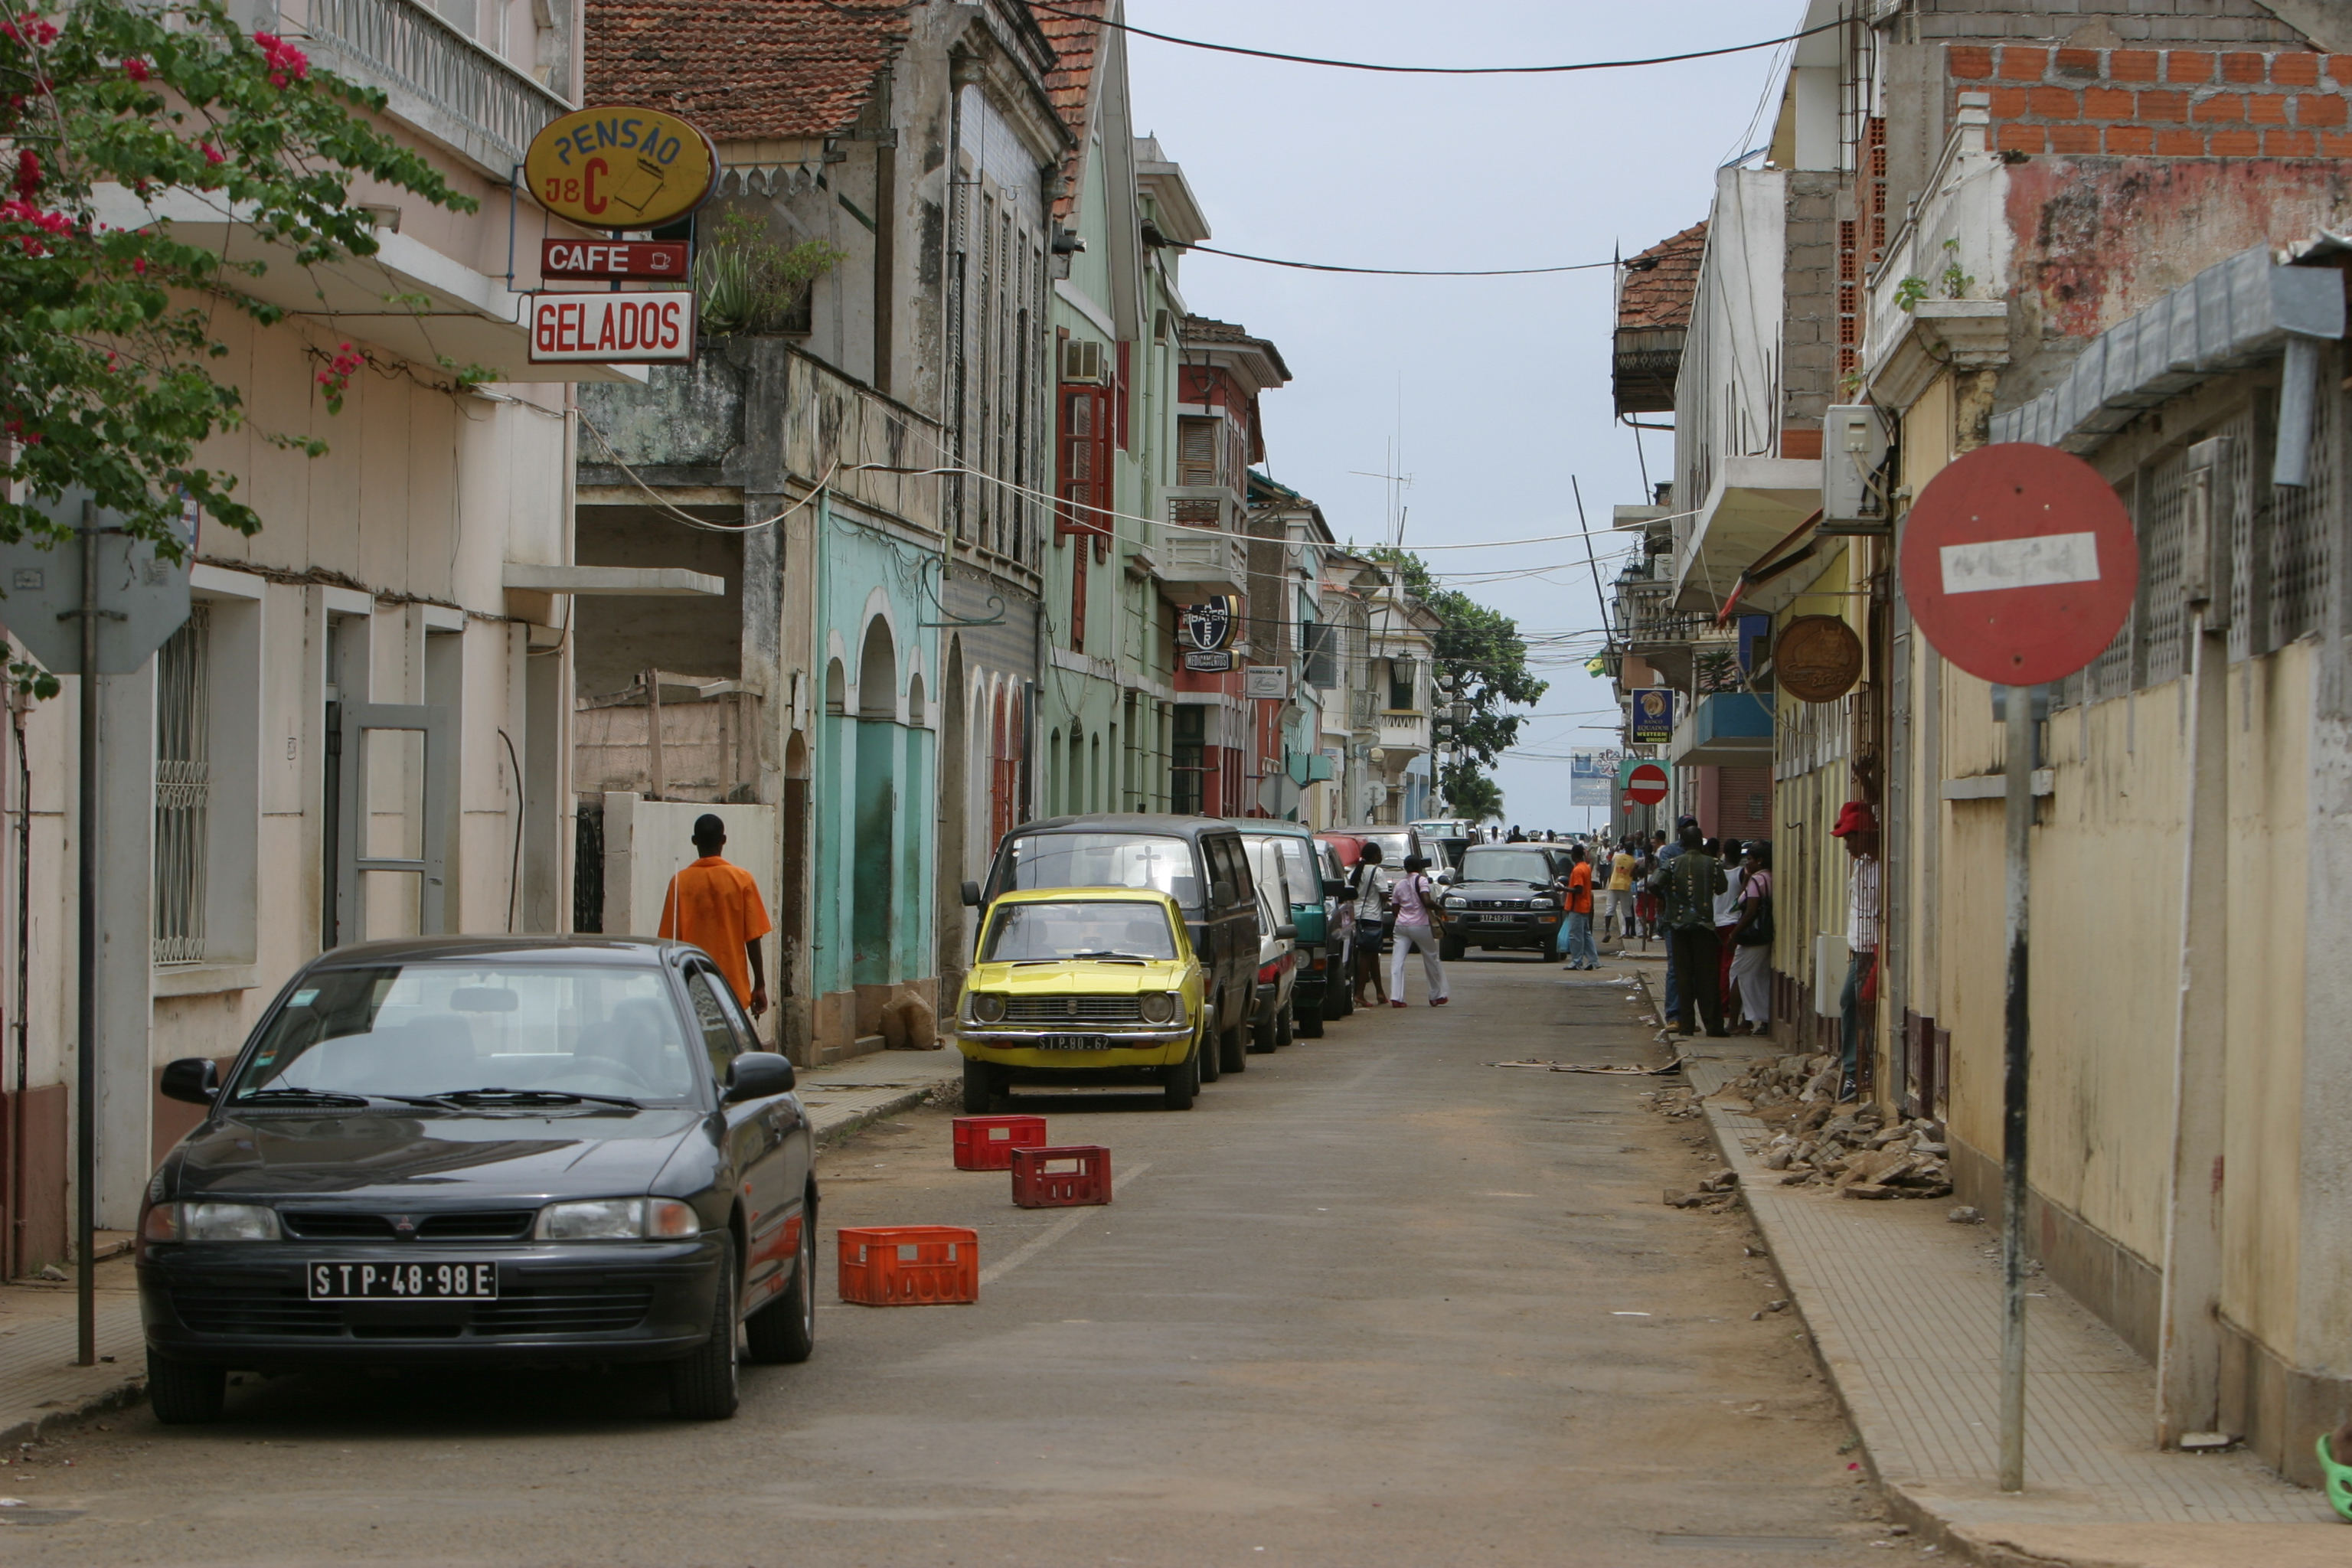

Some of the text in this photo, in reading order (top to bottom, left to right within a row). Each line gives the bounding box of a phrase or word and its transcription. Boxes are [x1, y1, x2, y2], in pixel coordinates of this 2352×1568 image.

[554, 118, 681, 166] PENSÃO
[548, 244, 629, 273] CAFE
[537, 301, 681, 352] GELADOS
[1191, 609, 1226, 623] BAYER
